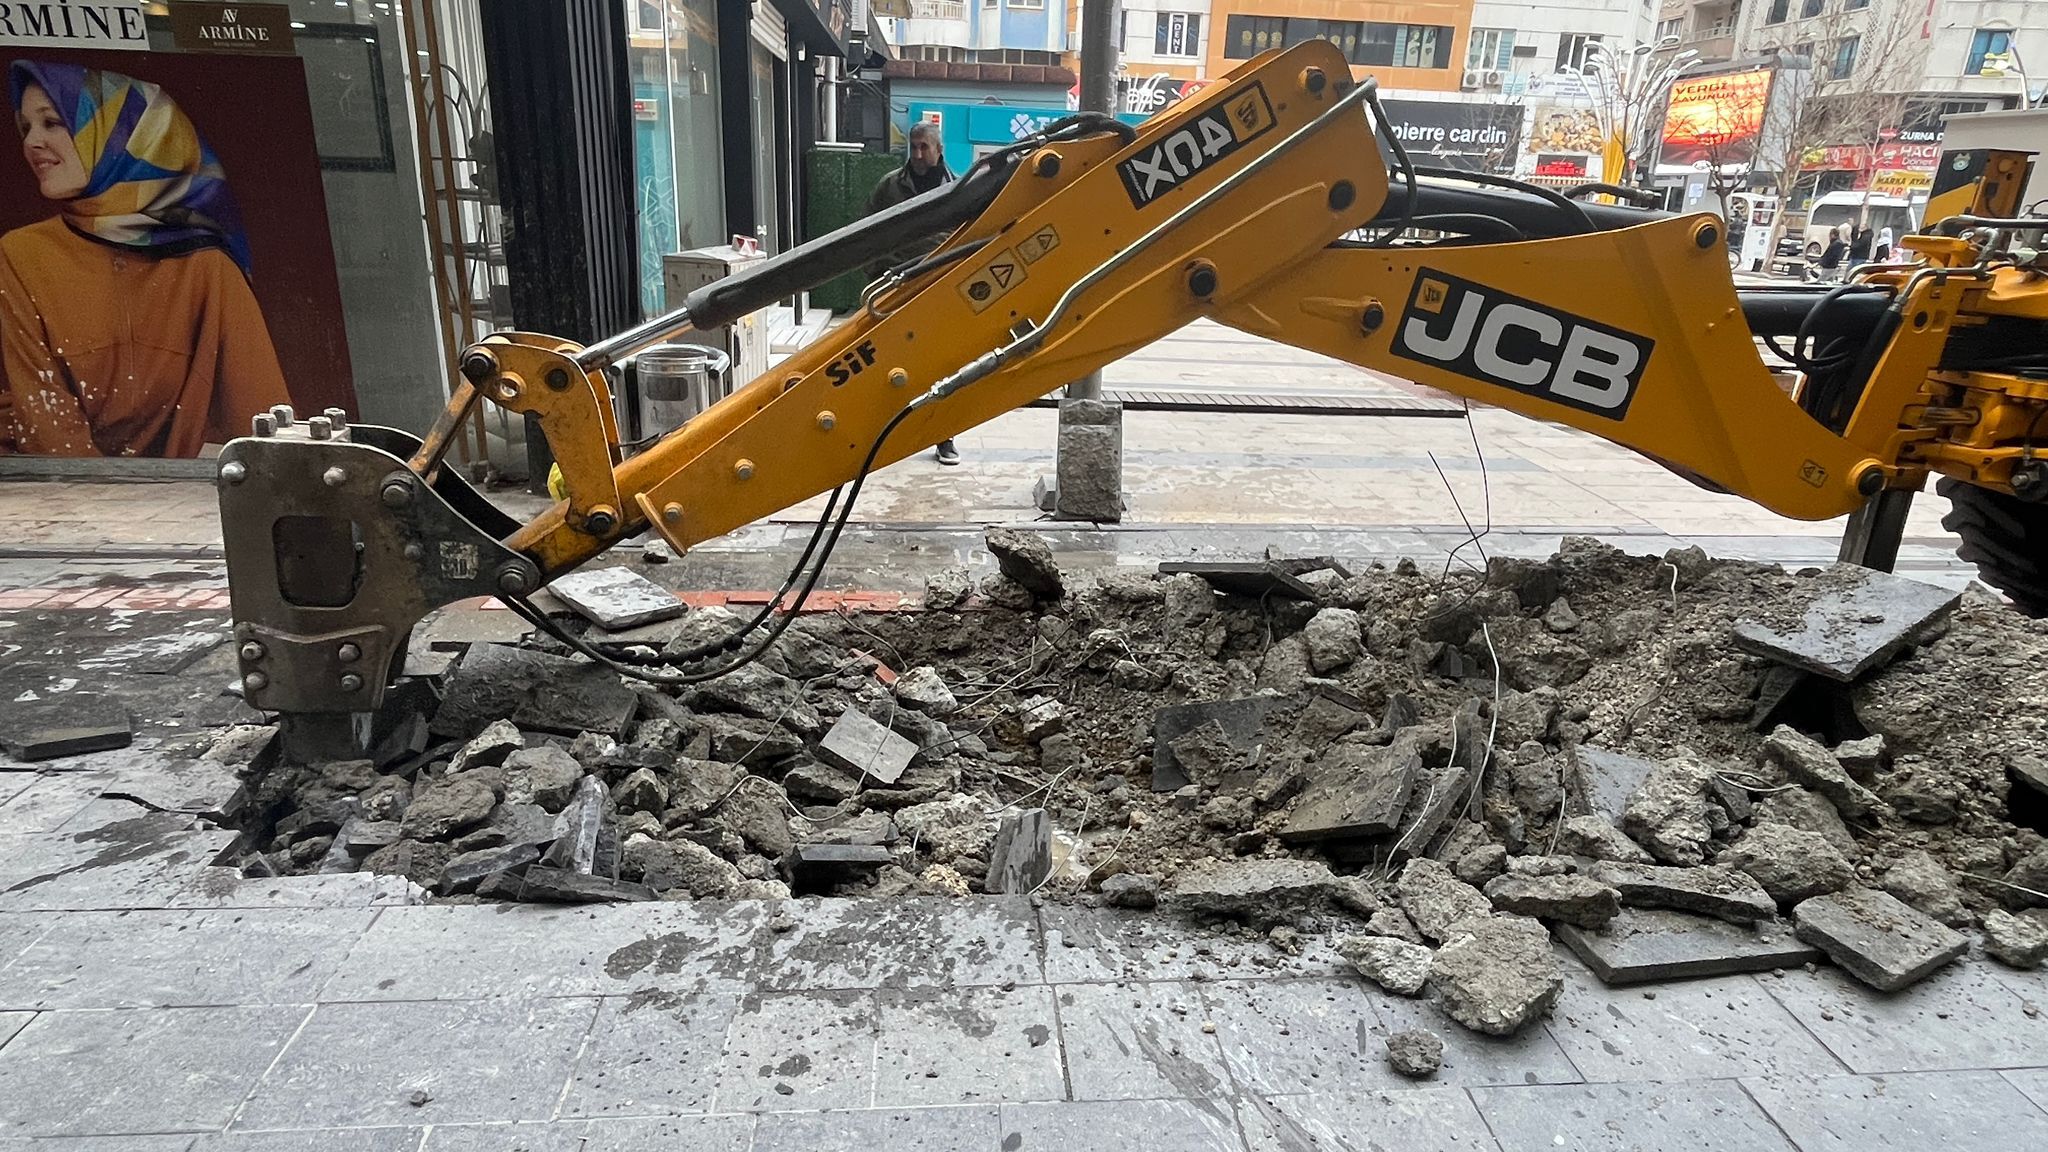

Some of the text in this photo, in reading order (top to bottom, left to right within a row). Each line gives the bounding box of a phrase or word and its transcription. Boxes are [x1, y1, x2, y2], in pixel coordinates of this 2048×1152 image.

[199, 24, 269, 41] ARMİNE
[1173, 23, 1182, 53] DENT
[1449, 125, 1507, 144] cardin
[1900, 131, 1935, 141] ZURNA
[1403, 290, 1640, 409] JCB
